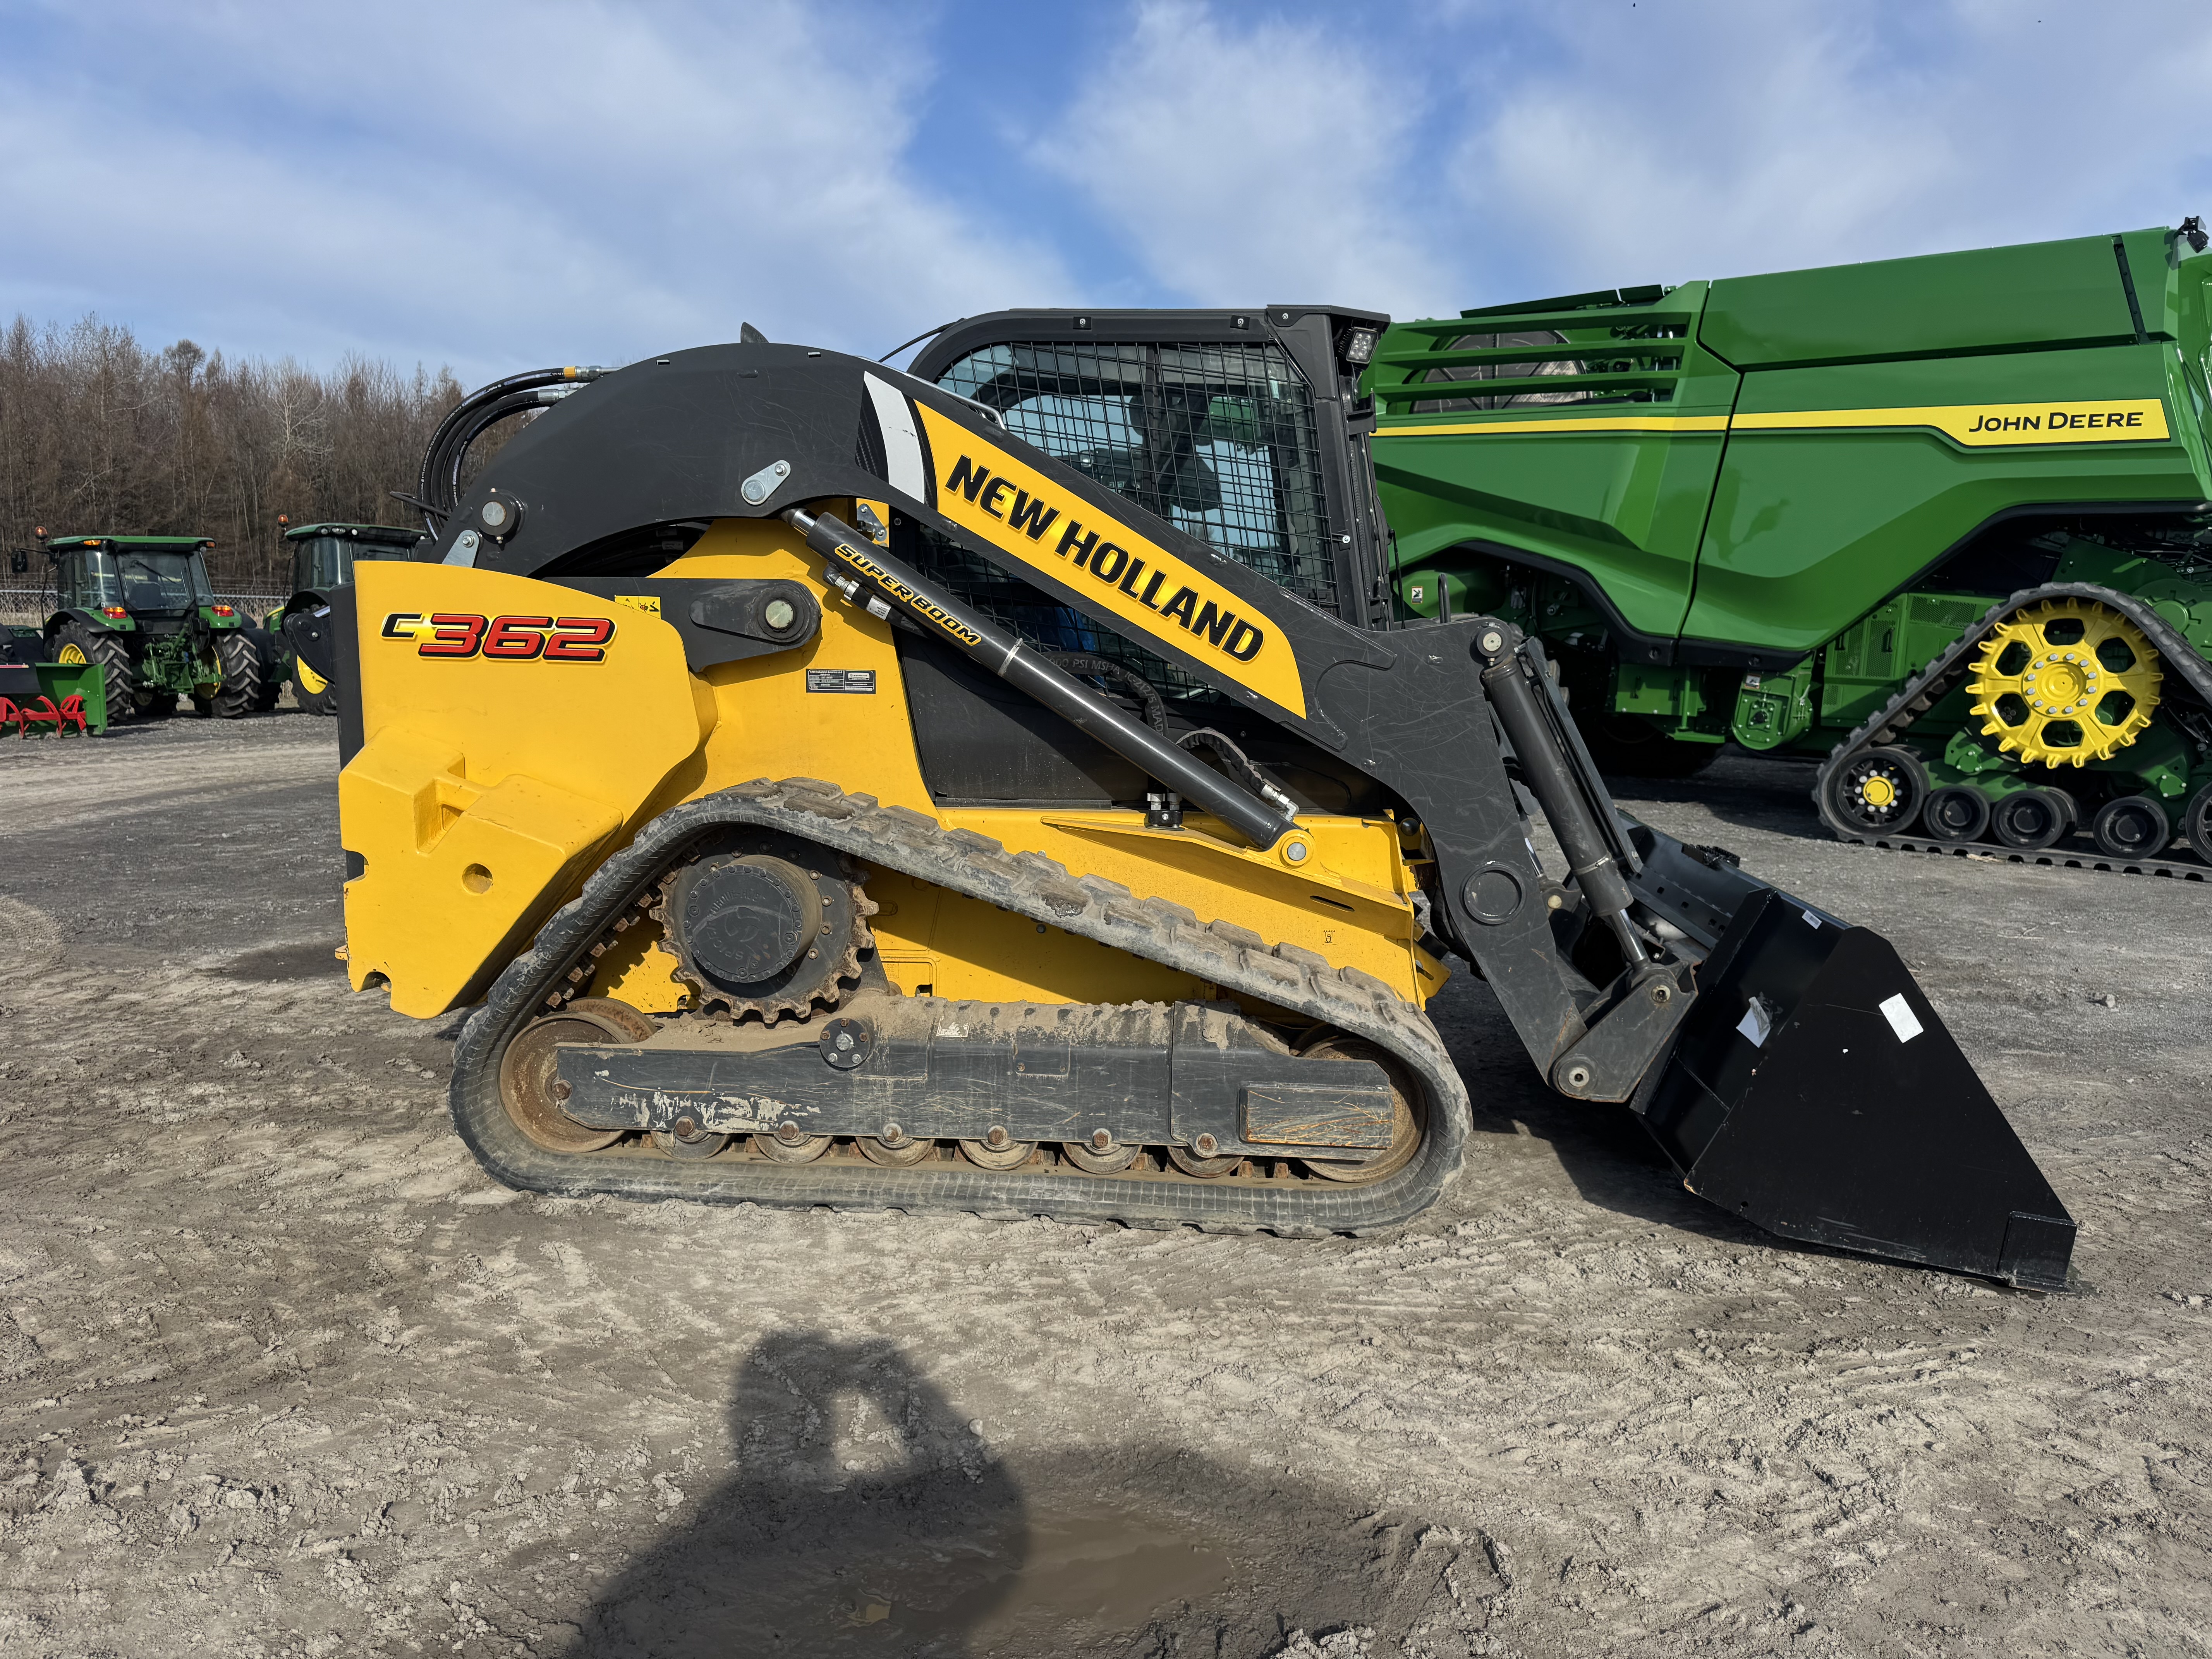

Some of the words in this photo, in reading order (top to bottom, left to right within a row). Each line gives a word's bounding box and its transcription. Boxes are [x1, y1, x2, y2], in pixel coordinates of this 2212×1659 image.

[1969, 415, 2041, 433] JOHN
[2048, 412, 2144, 430] DEERE
[835, 543, 913, 602] SUPER
[911, 595, 981, 647] BOOM
[945, 454, 1060, 542] NEW
[1055, 519, 1264, 663] HOLLAND
[381, 613, 616, 662] C362
[1072, 659, 1088, 668] PSI
[1091, 660, 1120, 675] MSHA
[1151, 705, 1164, 736] MAD
